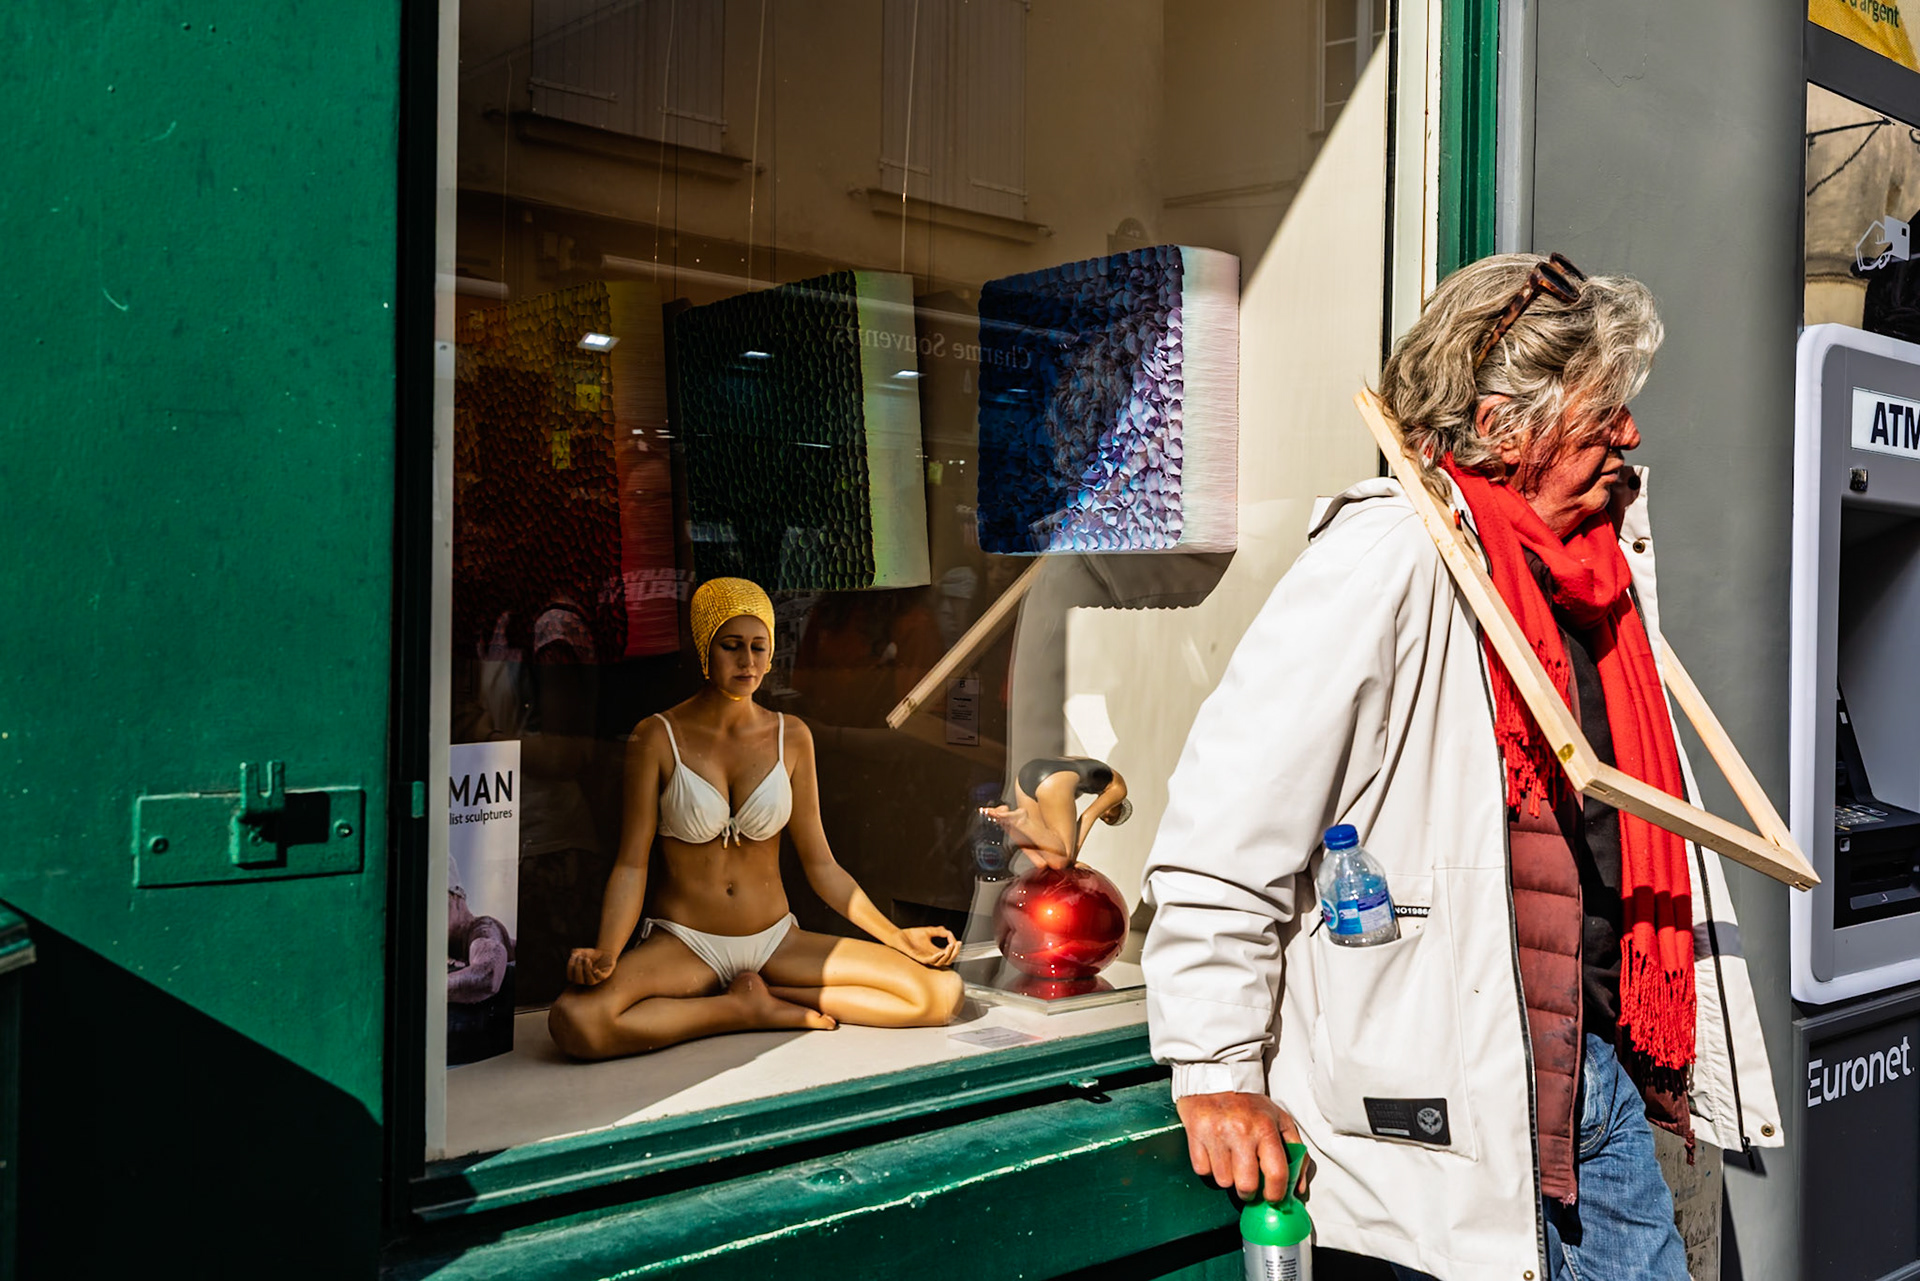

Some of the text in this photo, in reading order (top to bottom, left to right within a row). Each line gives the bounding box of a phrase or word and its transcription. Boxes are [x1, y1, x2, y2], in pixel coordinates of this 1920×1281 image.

[1850, 0, 1899, 28] argent
[1870, 401, 1920, 450] ATM
[449, 770, 513, 809] MAN
[465, 808, 513, 826] sculptures
[1807, 1036, 1912, 1108] Euronet
